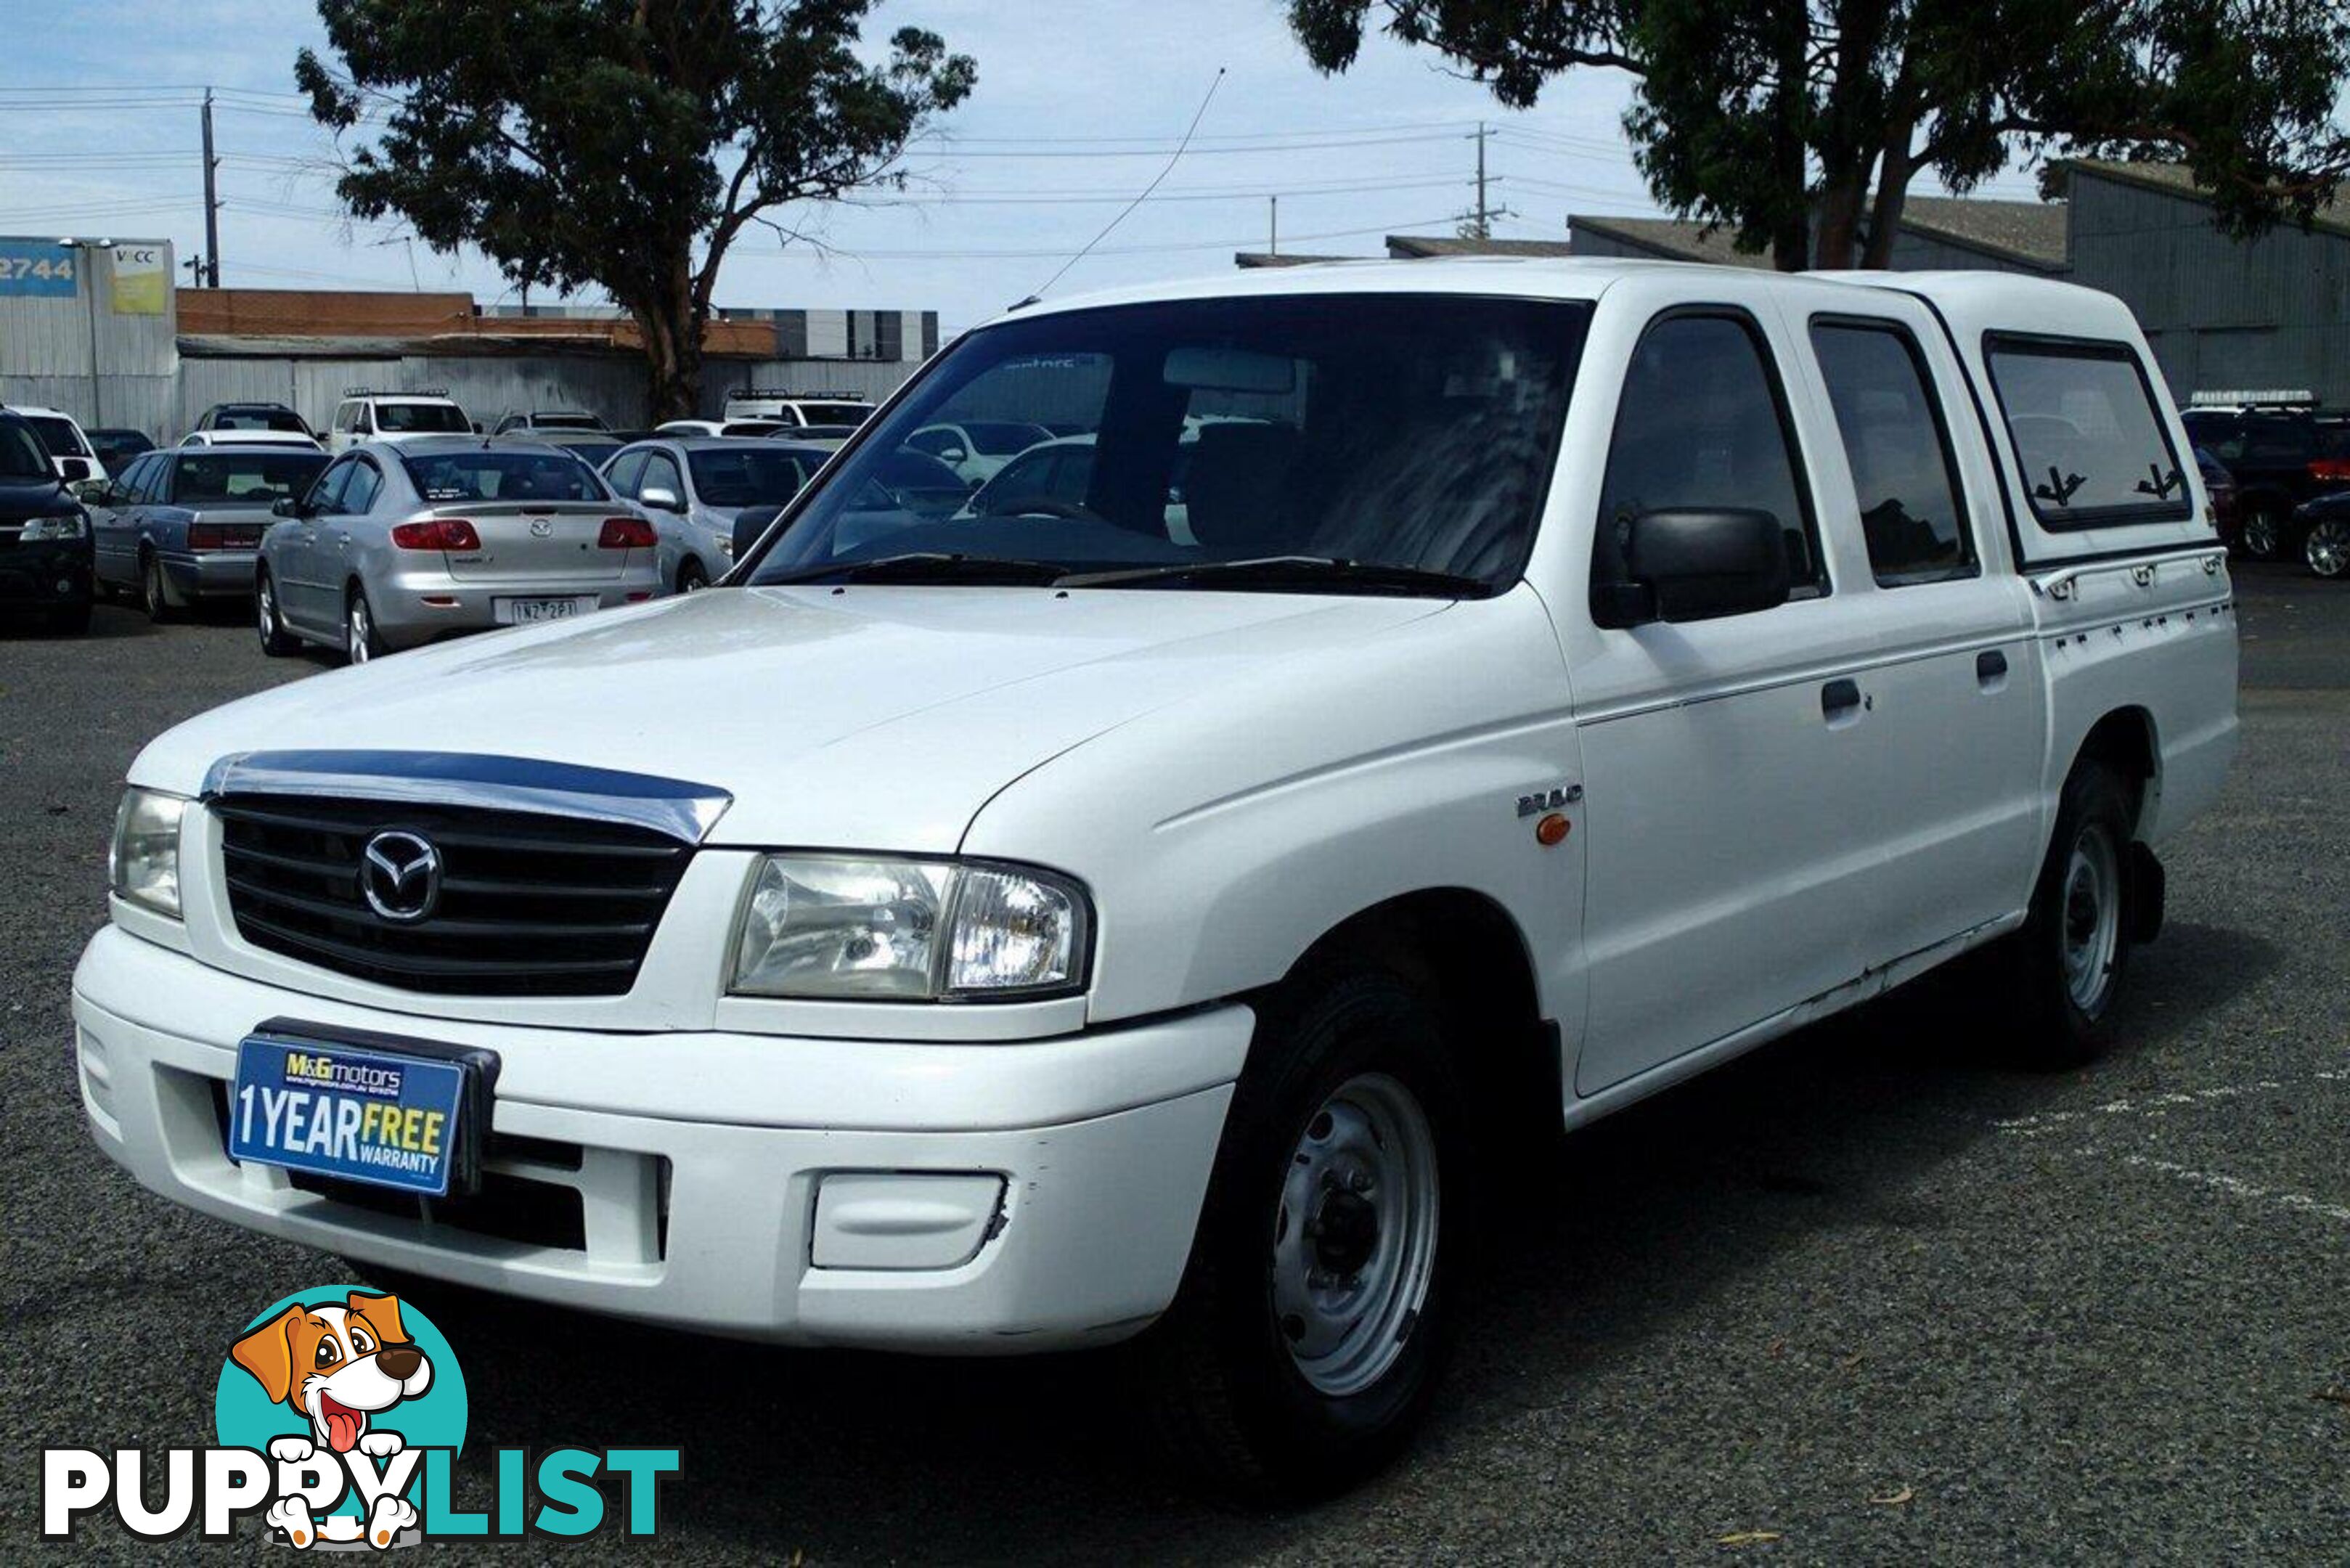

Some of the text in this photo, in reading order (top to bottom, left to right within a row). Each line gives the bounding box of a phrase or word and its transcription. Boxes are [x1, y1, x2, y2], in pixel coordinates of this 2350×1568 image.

[240, 1085, 445, 1161] 1 YEAR FREE
[360, 1143, 440, 1175] WARRANTY
